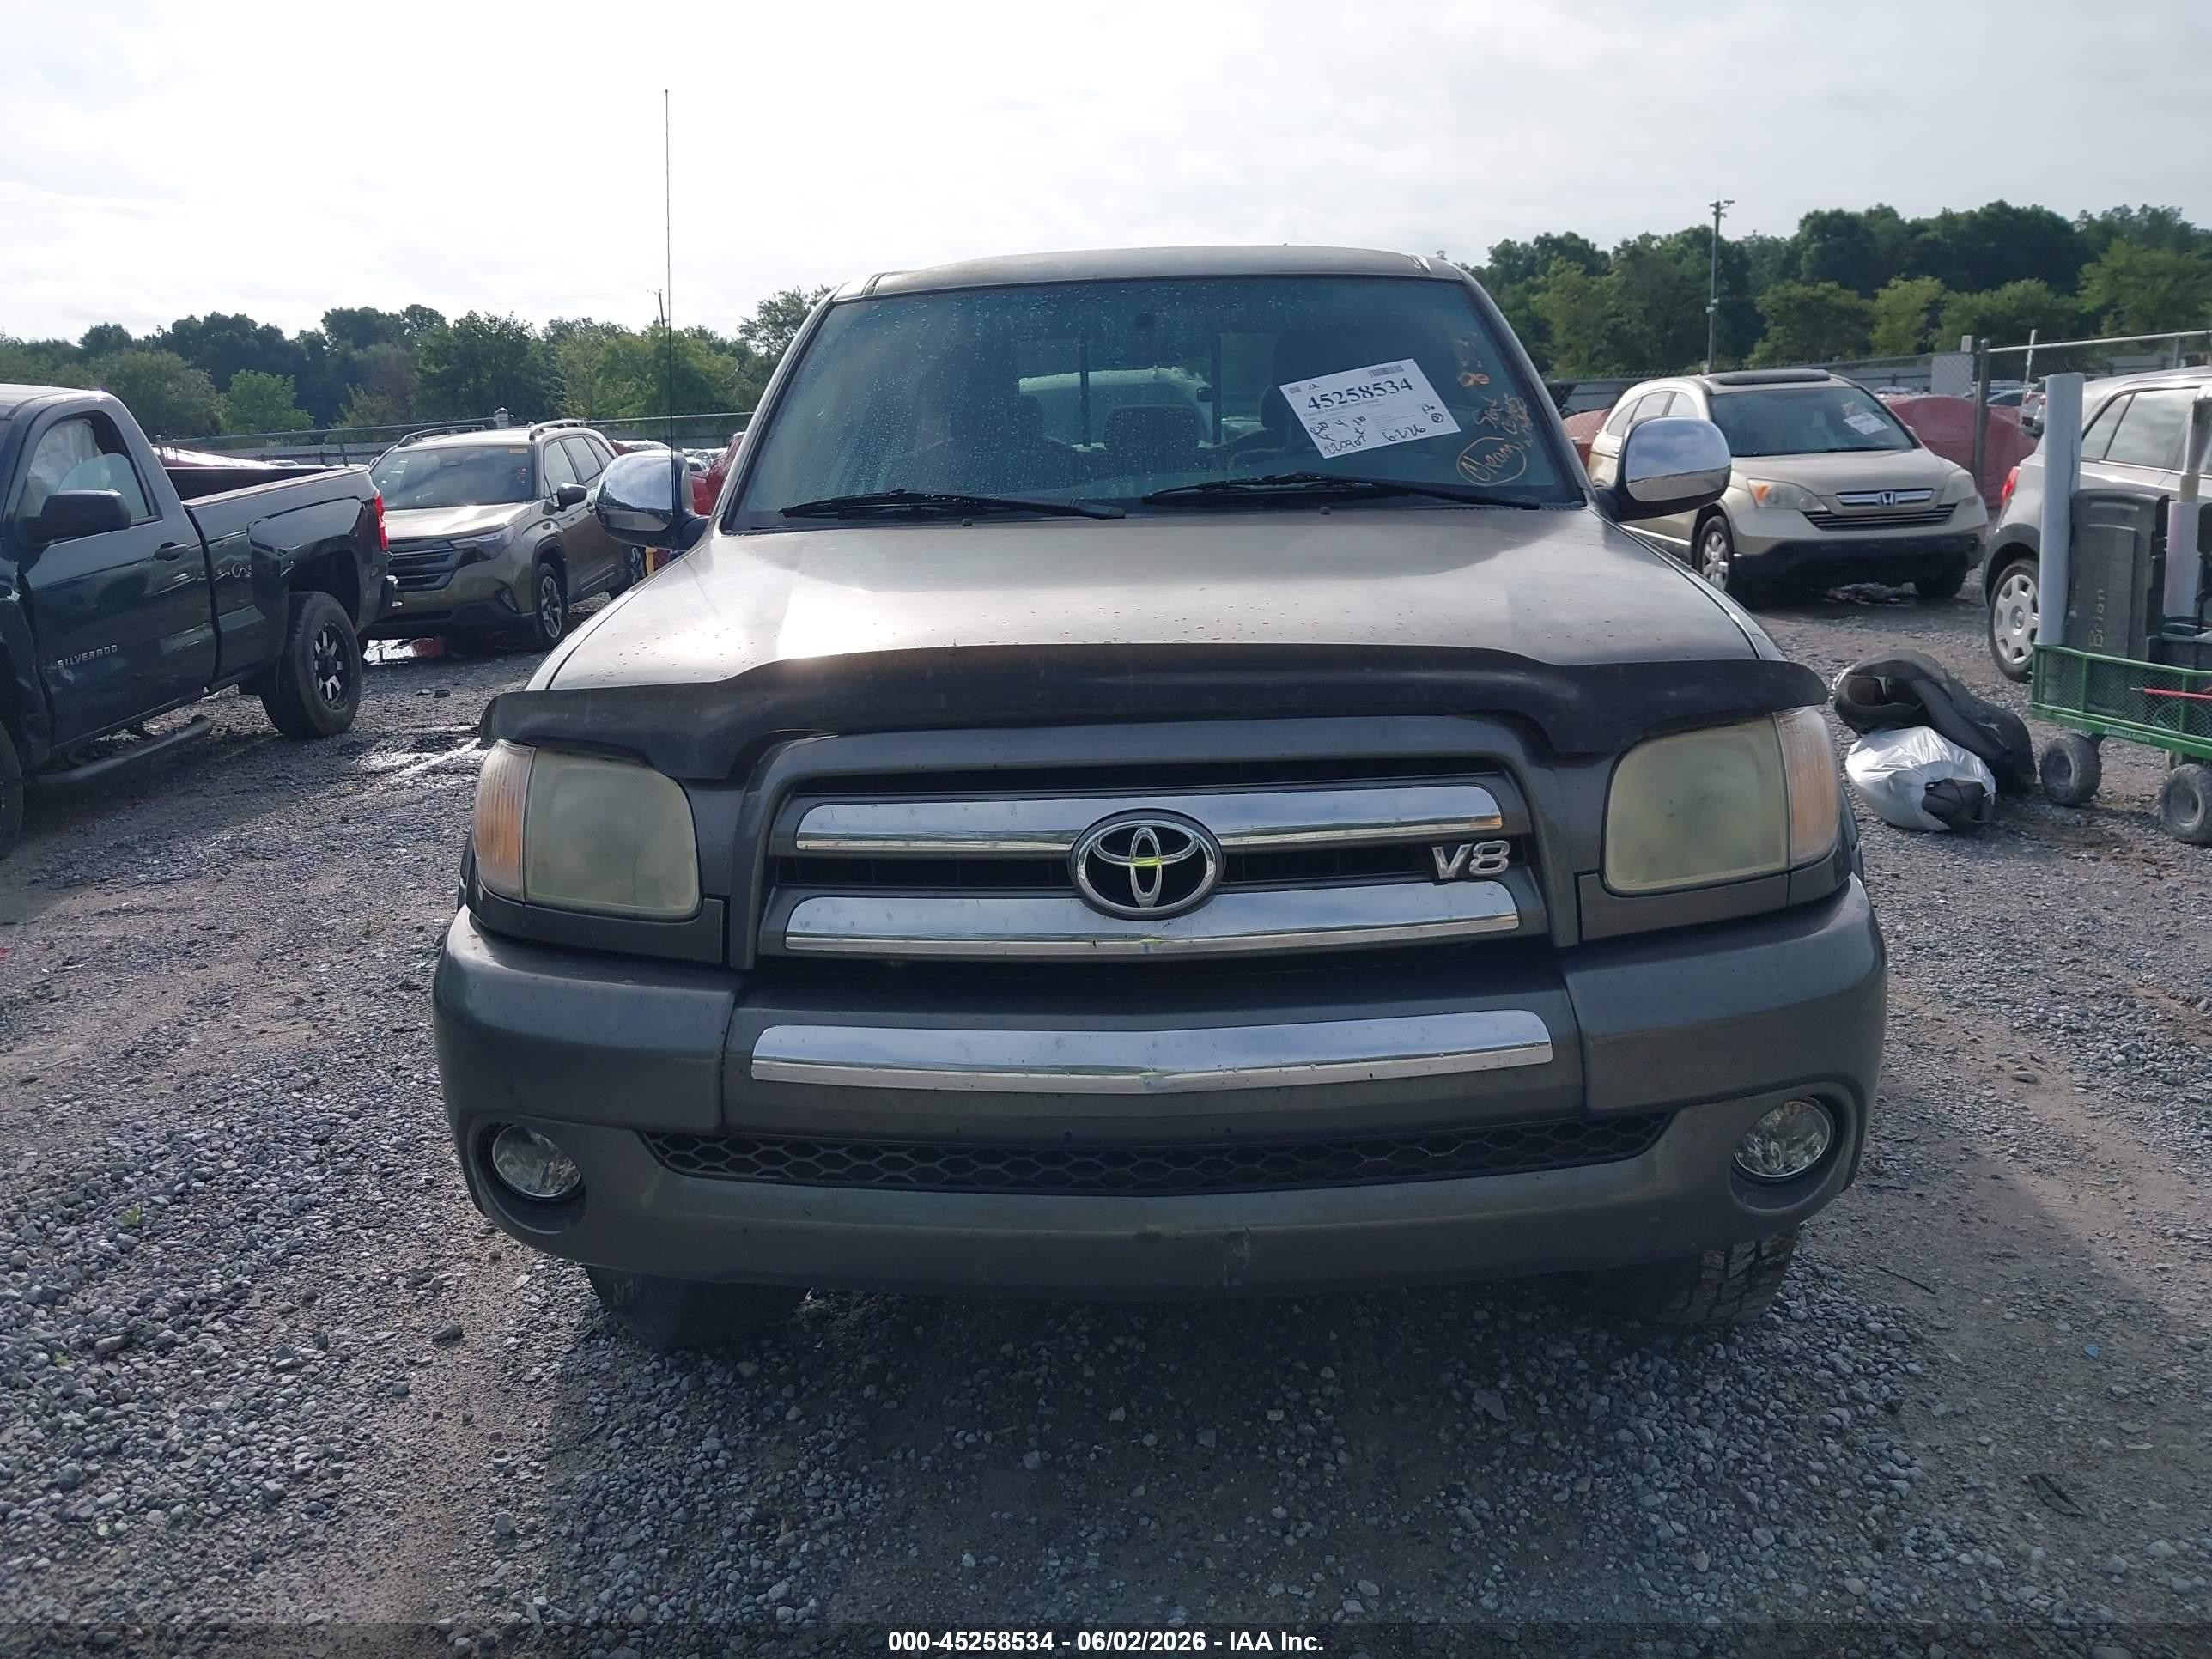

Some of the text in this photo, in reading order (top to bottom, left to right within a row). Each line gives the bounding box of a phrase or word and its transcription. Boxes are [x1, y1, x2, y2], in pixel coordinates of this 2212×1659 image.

[1307, 377, 1413, 410] 45258534
[2087, 588, 2106, 648] Brian
[57, 644, 118, 668] SILVERADO
[1431, 840, 1510, 880] V8
